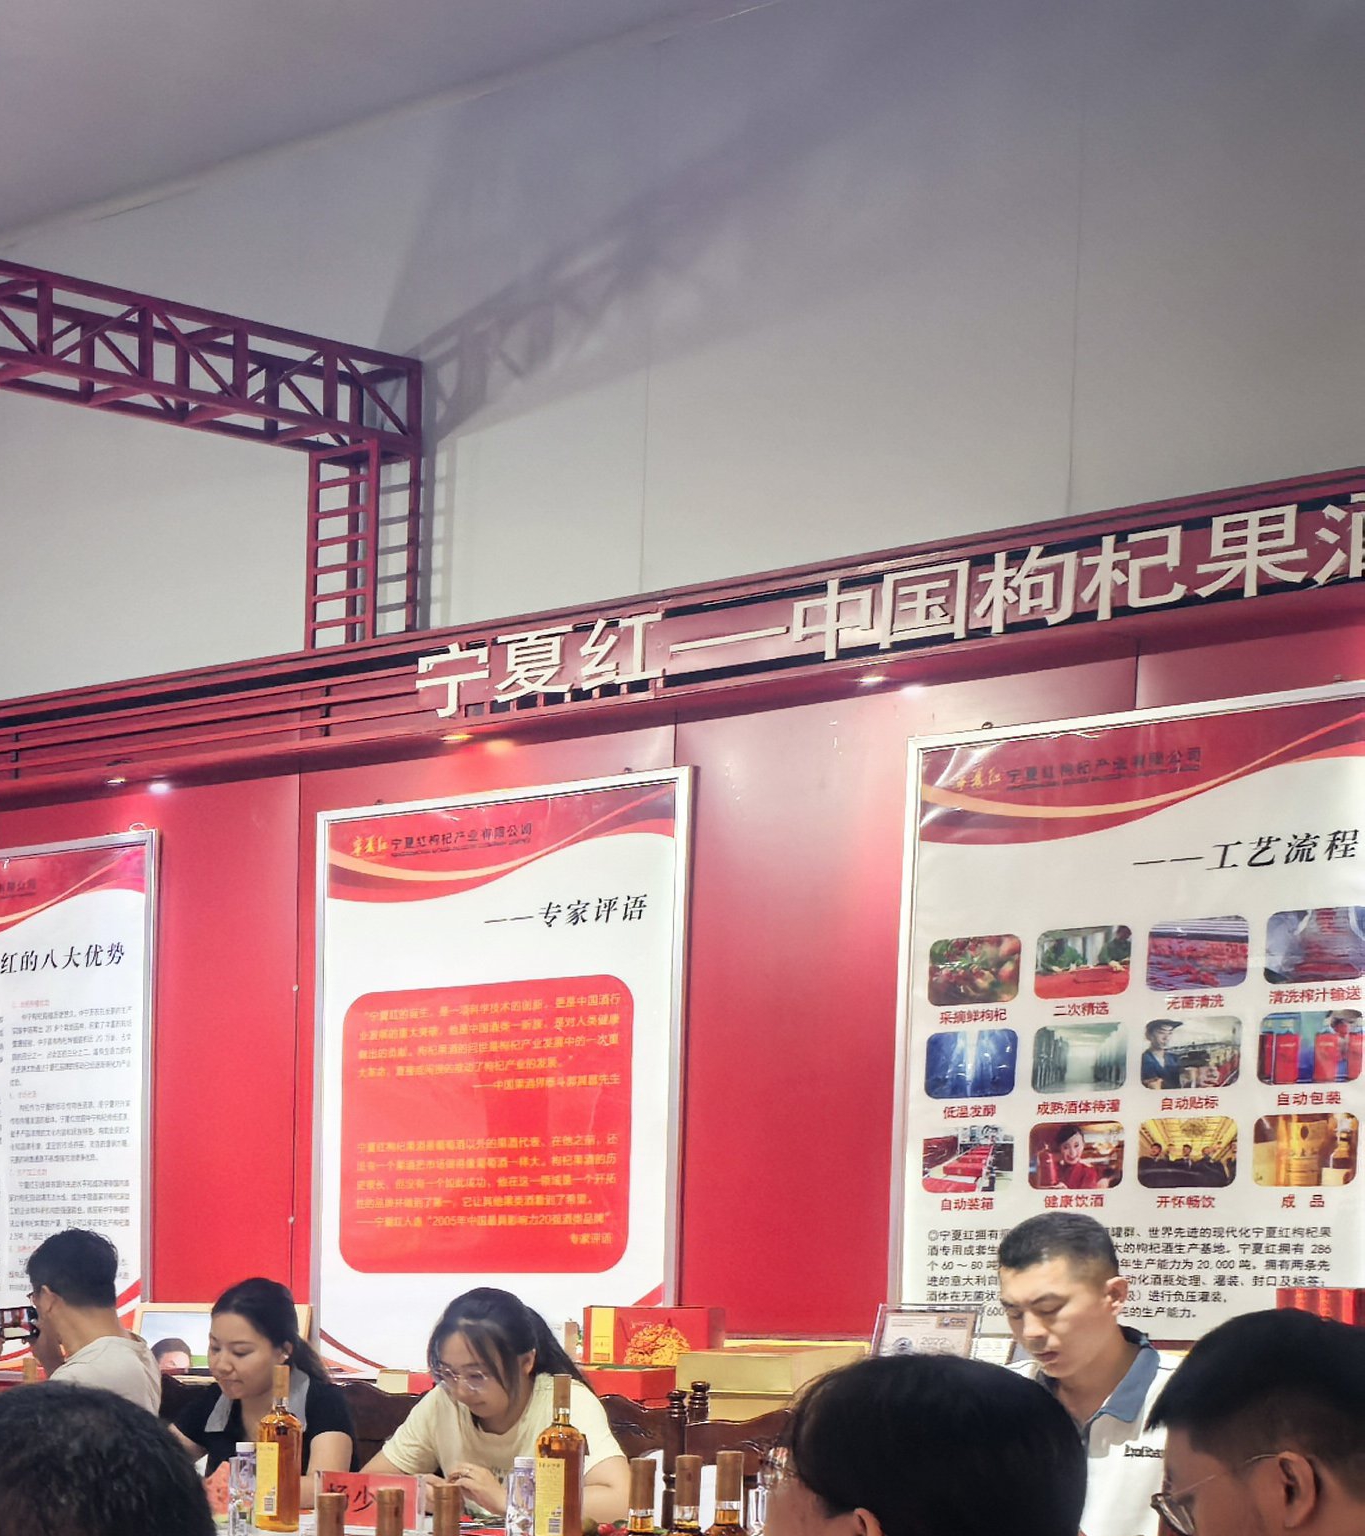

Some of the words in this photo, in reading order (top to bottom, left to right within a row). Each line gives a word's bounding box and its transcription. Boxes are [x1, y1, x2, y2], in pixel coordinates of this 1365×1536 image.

[1160, 1095, 1220, 1112] 自动贴标
[1276, 1091, 1342, 1107] 自动包装
[940, 1197, 995, 1212] 自动装箱
[1044, 1194, 1105, 1209] 健康饮酒
[1157, 1195, 1216, 1210] 开怀畅饮
